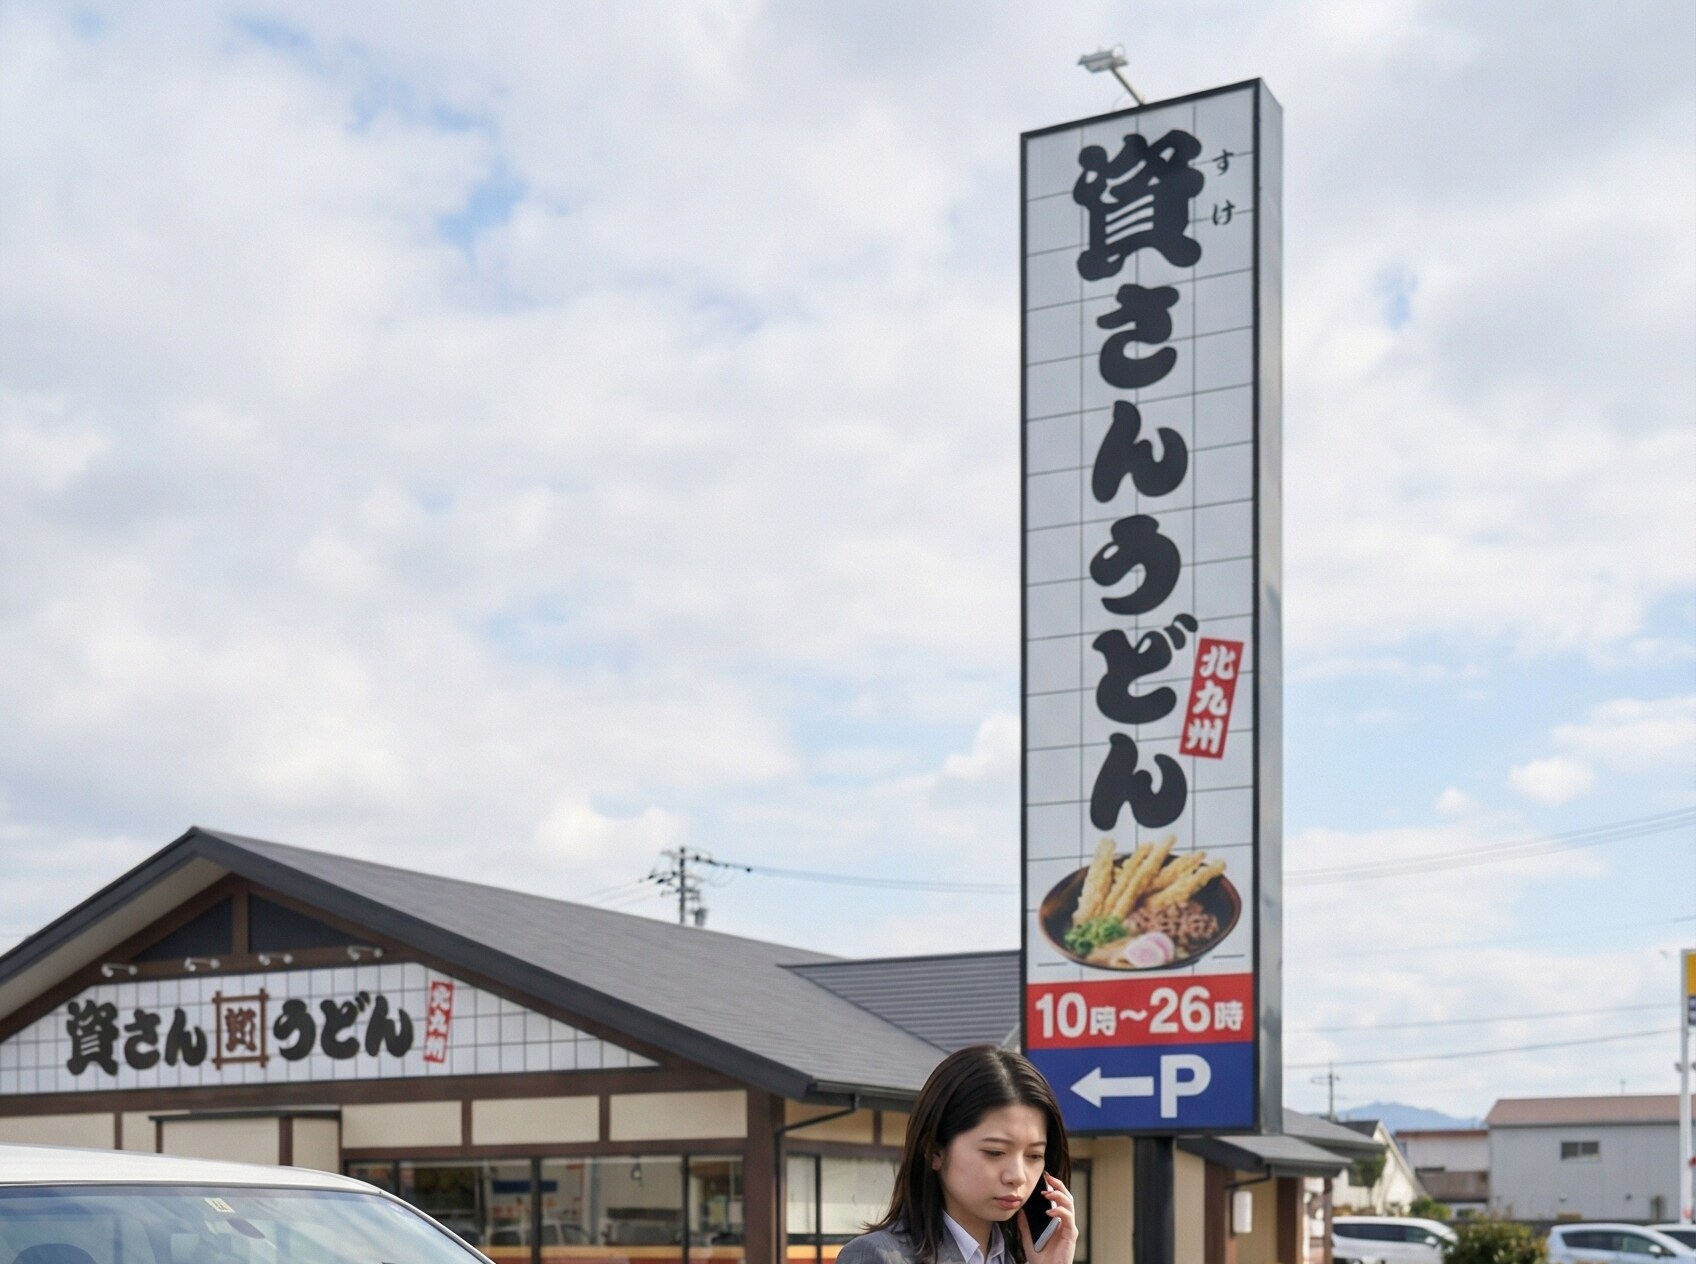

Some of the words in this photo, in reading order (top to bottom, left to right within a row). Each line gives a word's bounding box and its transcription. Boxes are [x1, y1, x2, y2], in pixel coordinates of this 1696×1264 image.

[1211, 149, 1236, 226] すけ
[1073, 129, 1204, 832] 資さんうどん
[1185, 644, 1237, 755] 北九州
[1160, 1053, 1212, 1119] P
